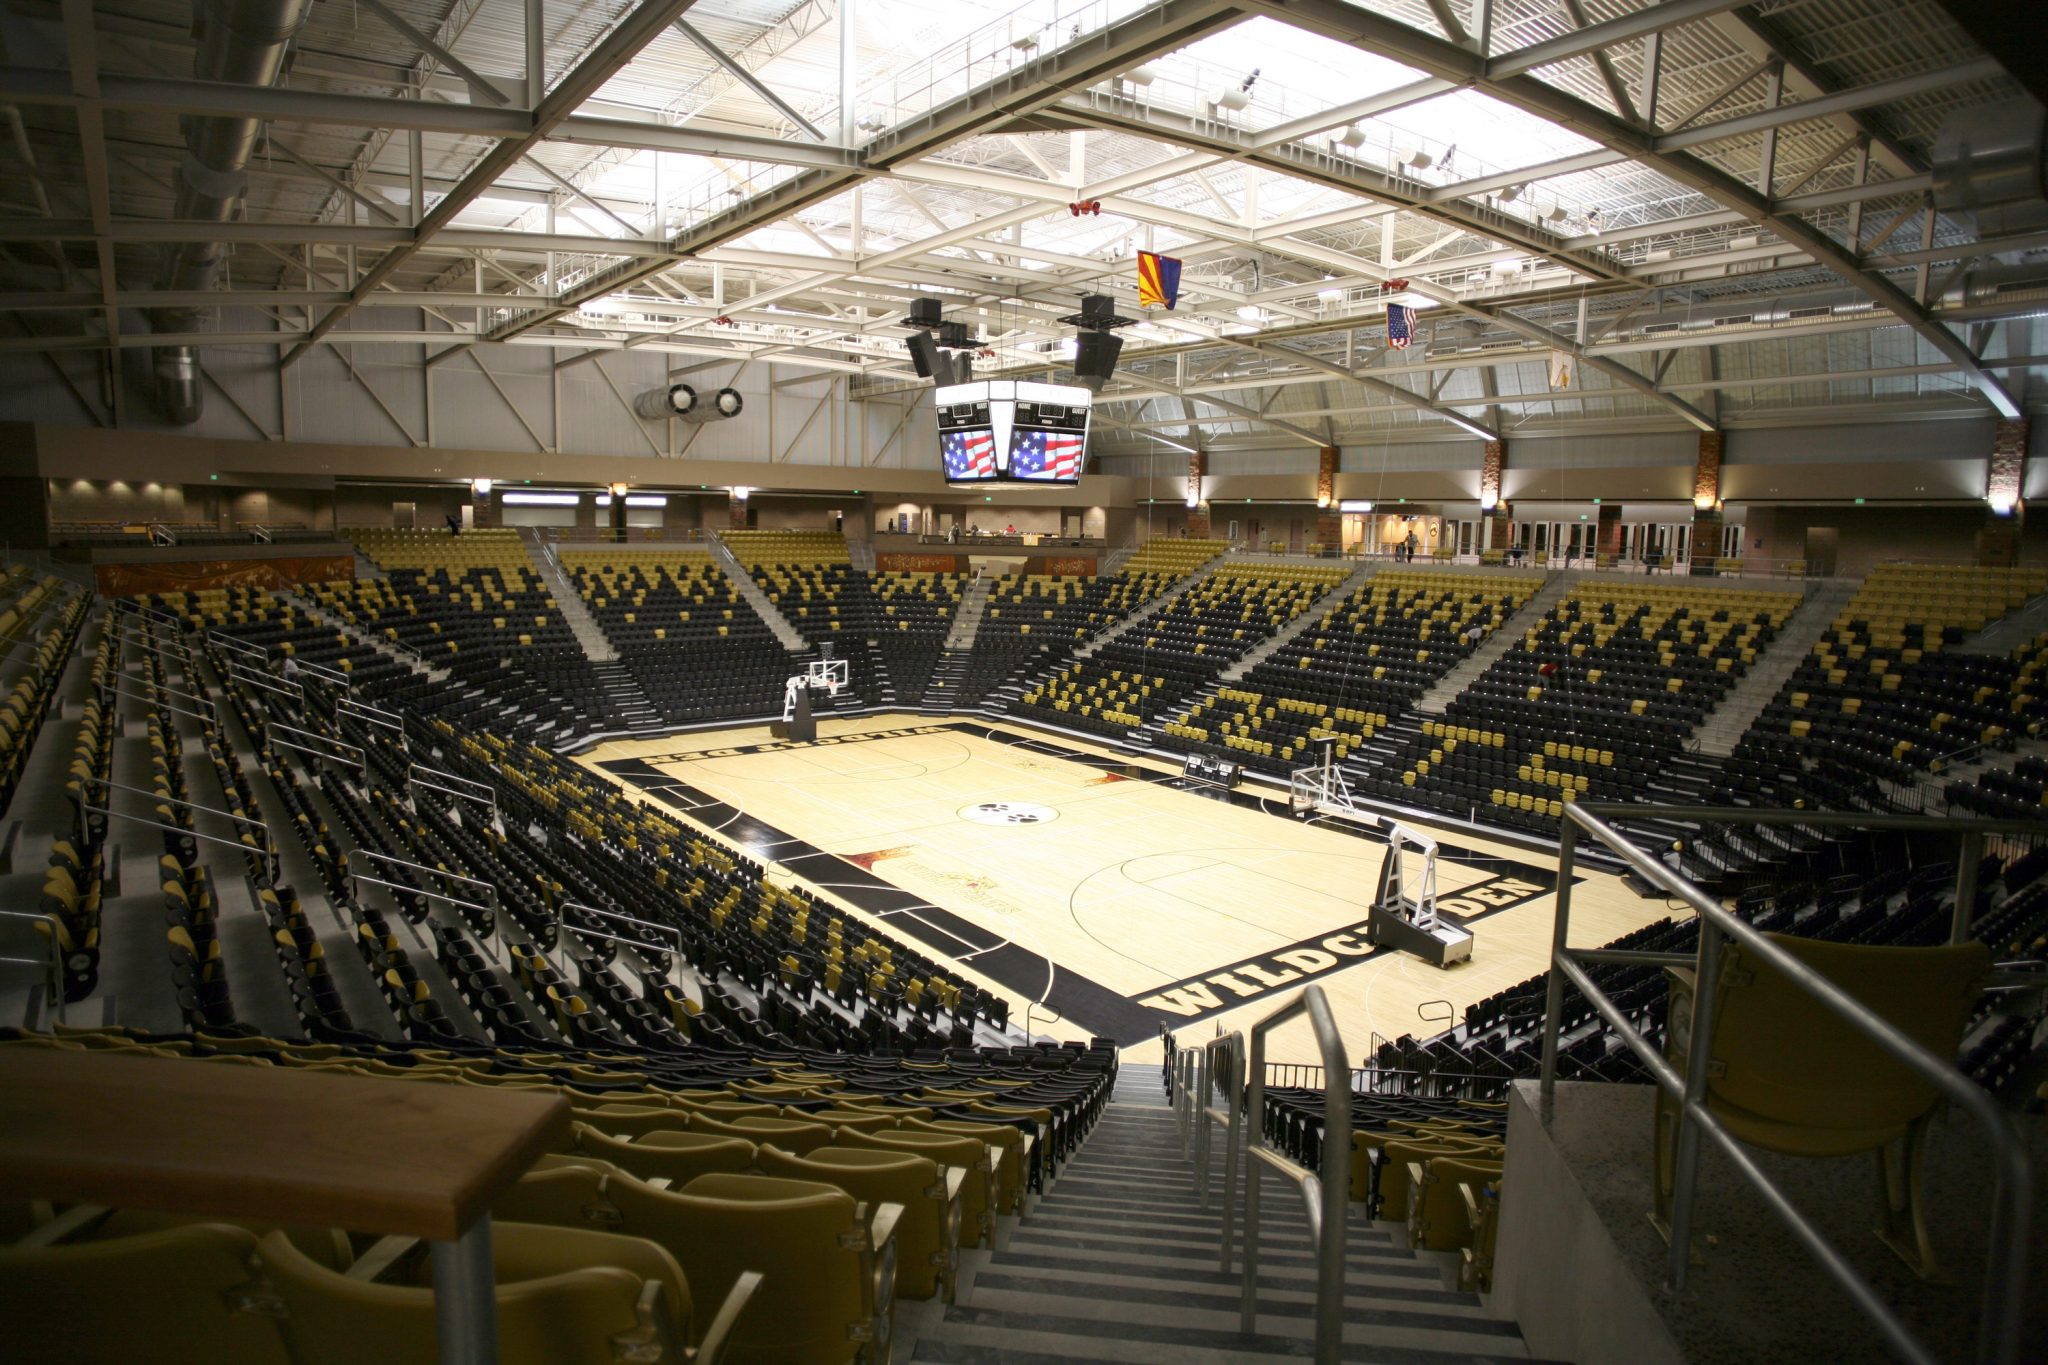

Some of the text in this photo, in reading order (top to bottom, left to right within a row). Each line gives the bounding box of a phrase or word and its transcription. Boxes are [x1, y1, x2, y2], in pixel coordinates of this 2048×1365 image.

[640, 749, 743, 765] DEN
[1140, 877, 1546, 1017] WILDC DEN
